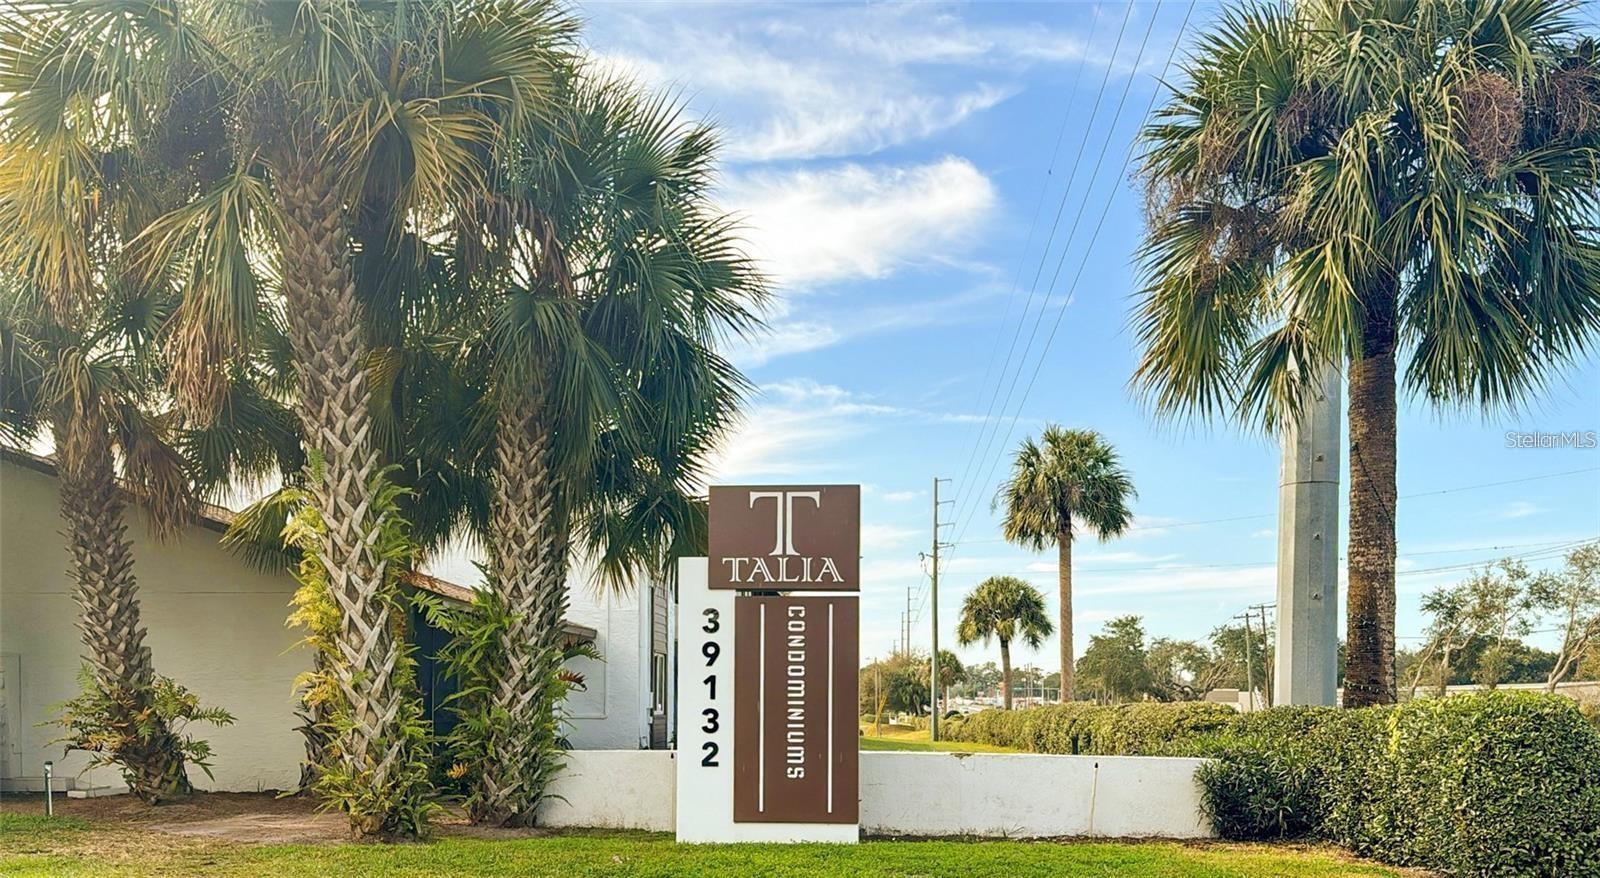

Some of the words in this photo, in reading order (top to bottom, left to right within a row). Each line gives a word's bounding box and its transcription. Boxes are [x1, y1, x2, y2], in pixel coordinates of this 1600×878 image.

[722, 557, 845, 583] TALIA
[750, 491, 820, 556] T
[701, 607, 720, 767] 39132
[787, 605, 806, 779] CONDOMINIUMS
